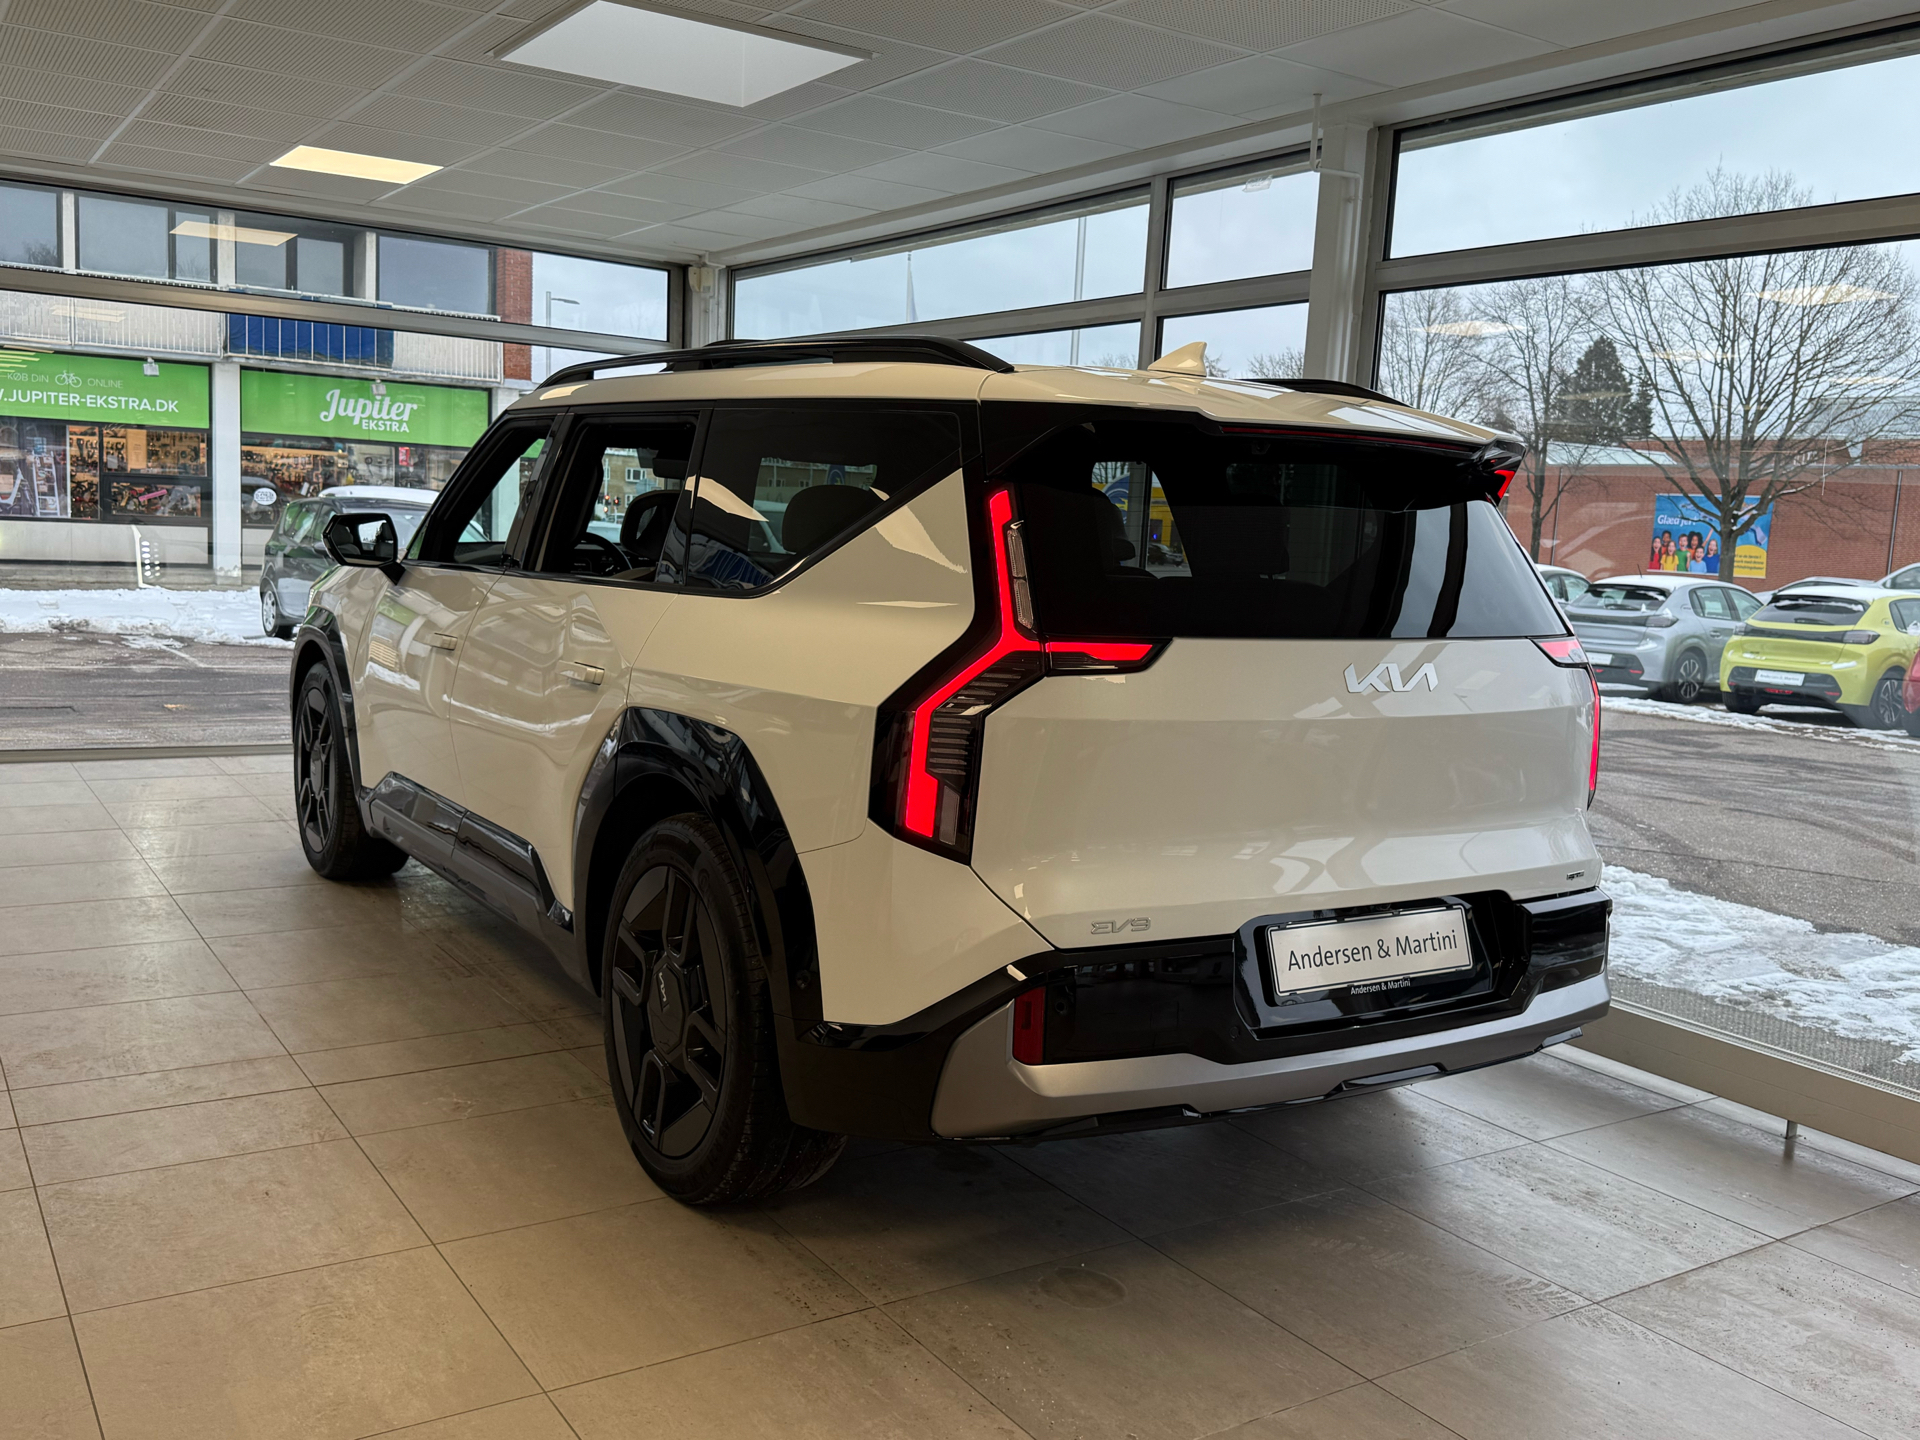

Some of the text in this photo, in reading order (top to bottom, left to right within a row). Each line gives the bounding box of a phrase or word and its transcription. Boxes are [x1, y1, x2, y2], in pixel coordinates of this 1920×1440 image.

[7, 372, 124, 388] KØB DIN ONLINE
[0, 388, 179, 413] .JUPITER-EKSTRA.DK
[320, 389, 418, 425] Jupiter
[361, 419, 410, 433] EKSTRA
[1091, 917, 1151, 934] EV9
[1287, 929, 1458, 972] Andersen & Martini
[1350, 979, 1411, 995] Andersen & Martini
